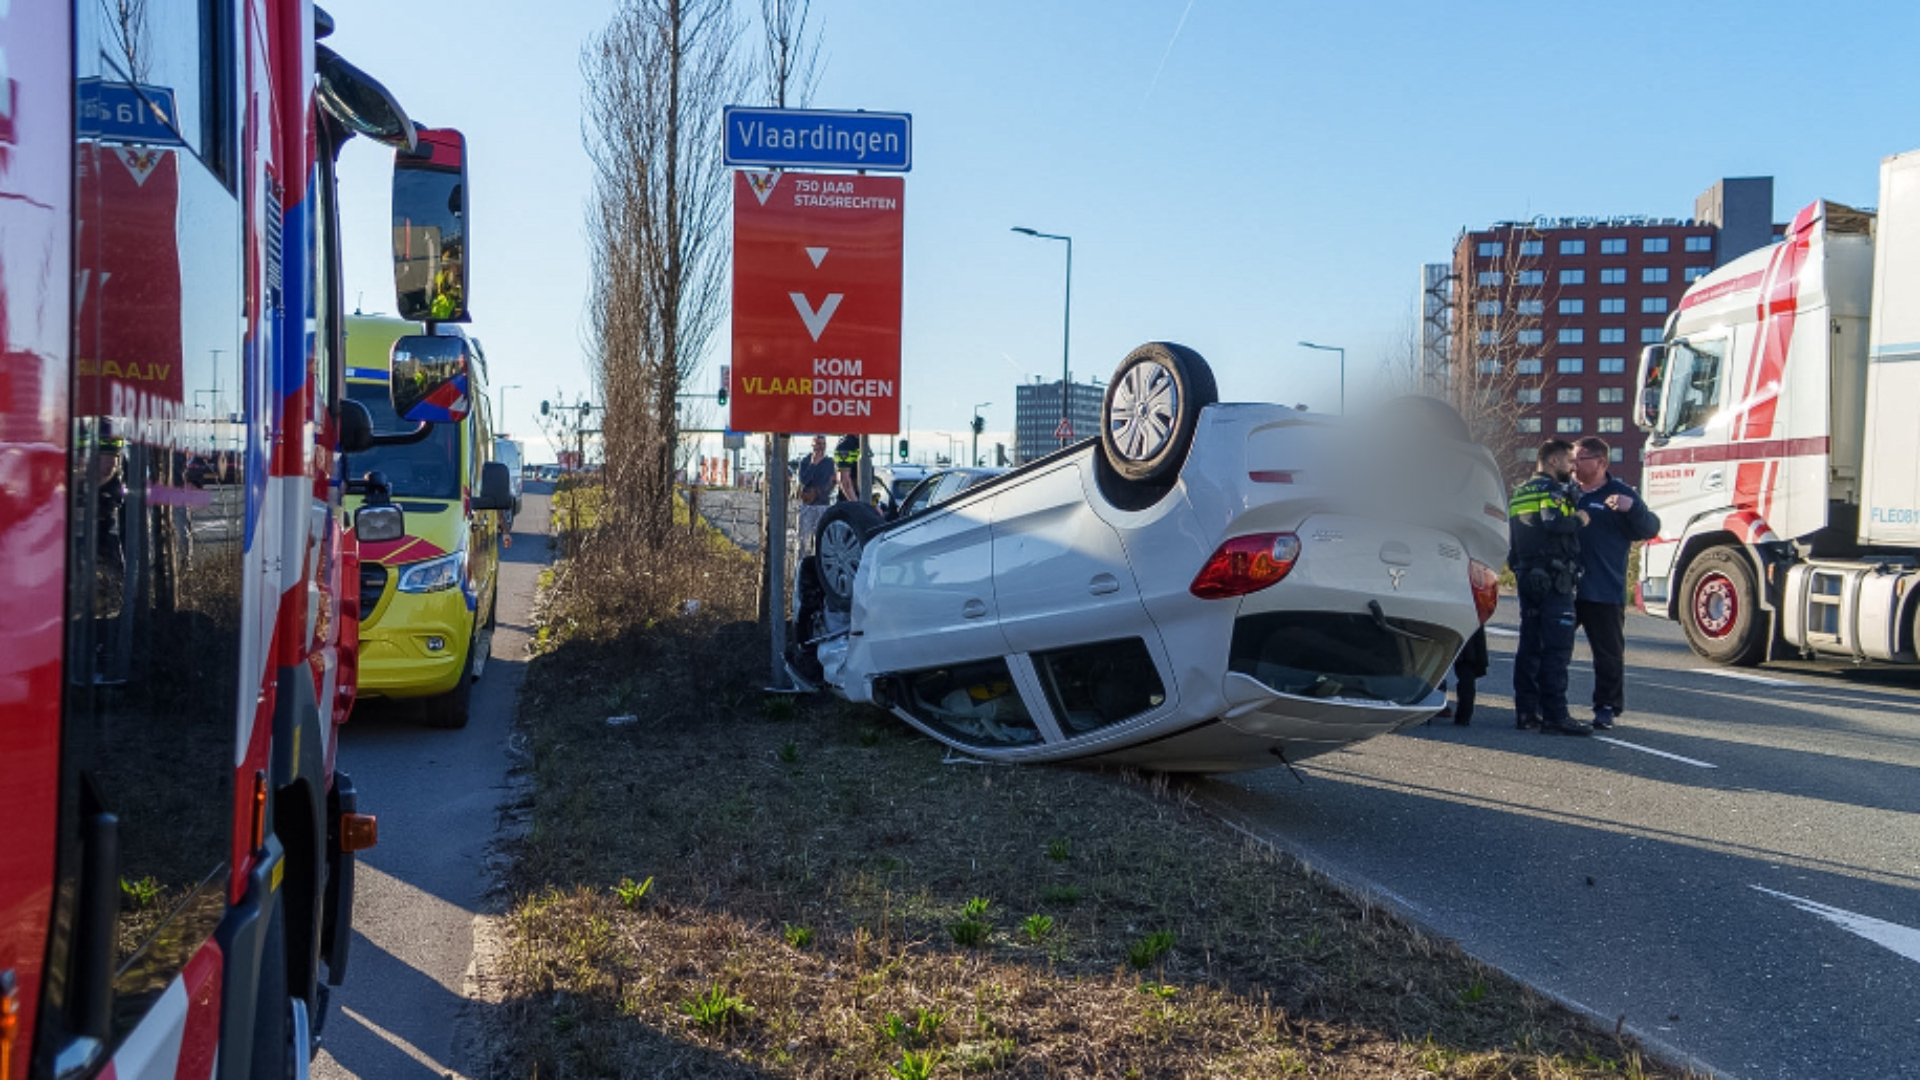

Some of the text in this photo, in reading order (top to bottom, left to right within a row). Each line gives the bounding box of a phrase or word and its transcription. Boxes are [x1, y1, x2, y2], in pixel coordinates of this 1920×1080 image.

[737, 120, 899, 160] Vlaardingen
[795, 179, 854, 194] 750 JAAR
[793, 194, 896, 210] STADSRECHTEN
[812, 358, 863, 377] KOM
[741, 377, 893, 397] VLAARDINGEN
[812, 399, 872, 417] DOEN
